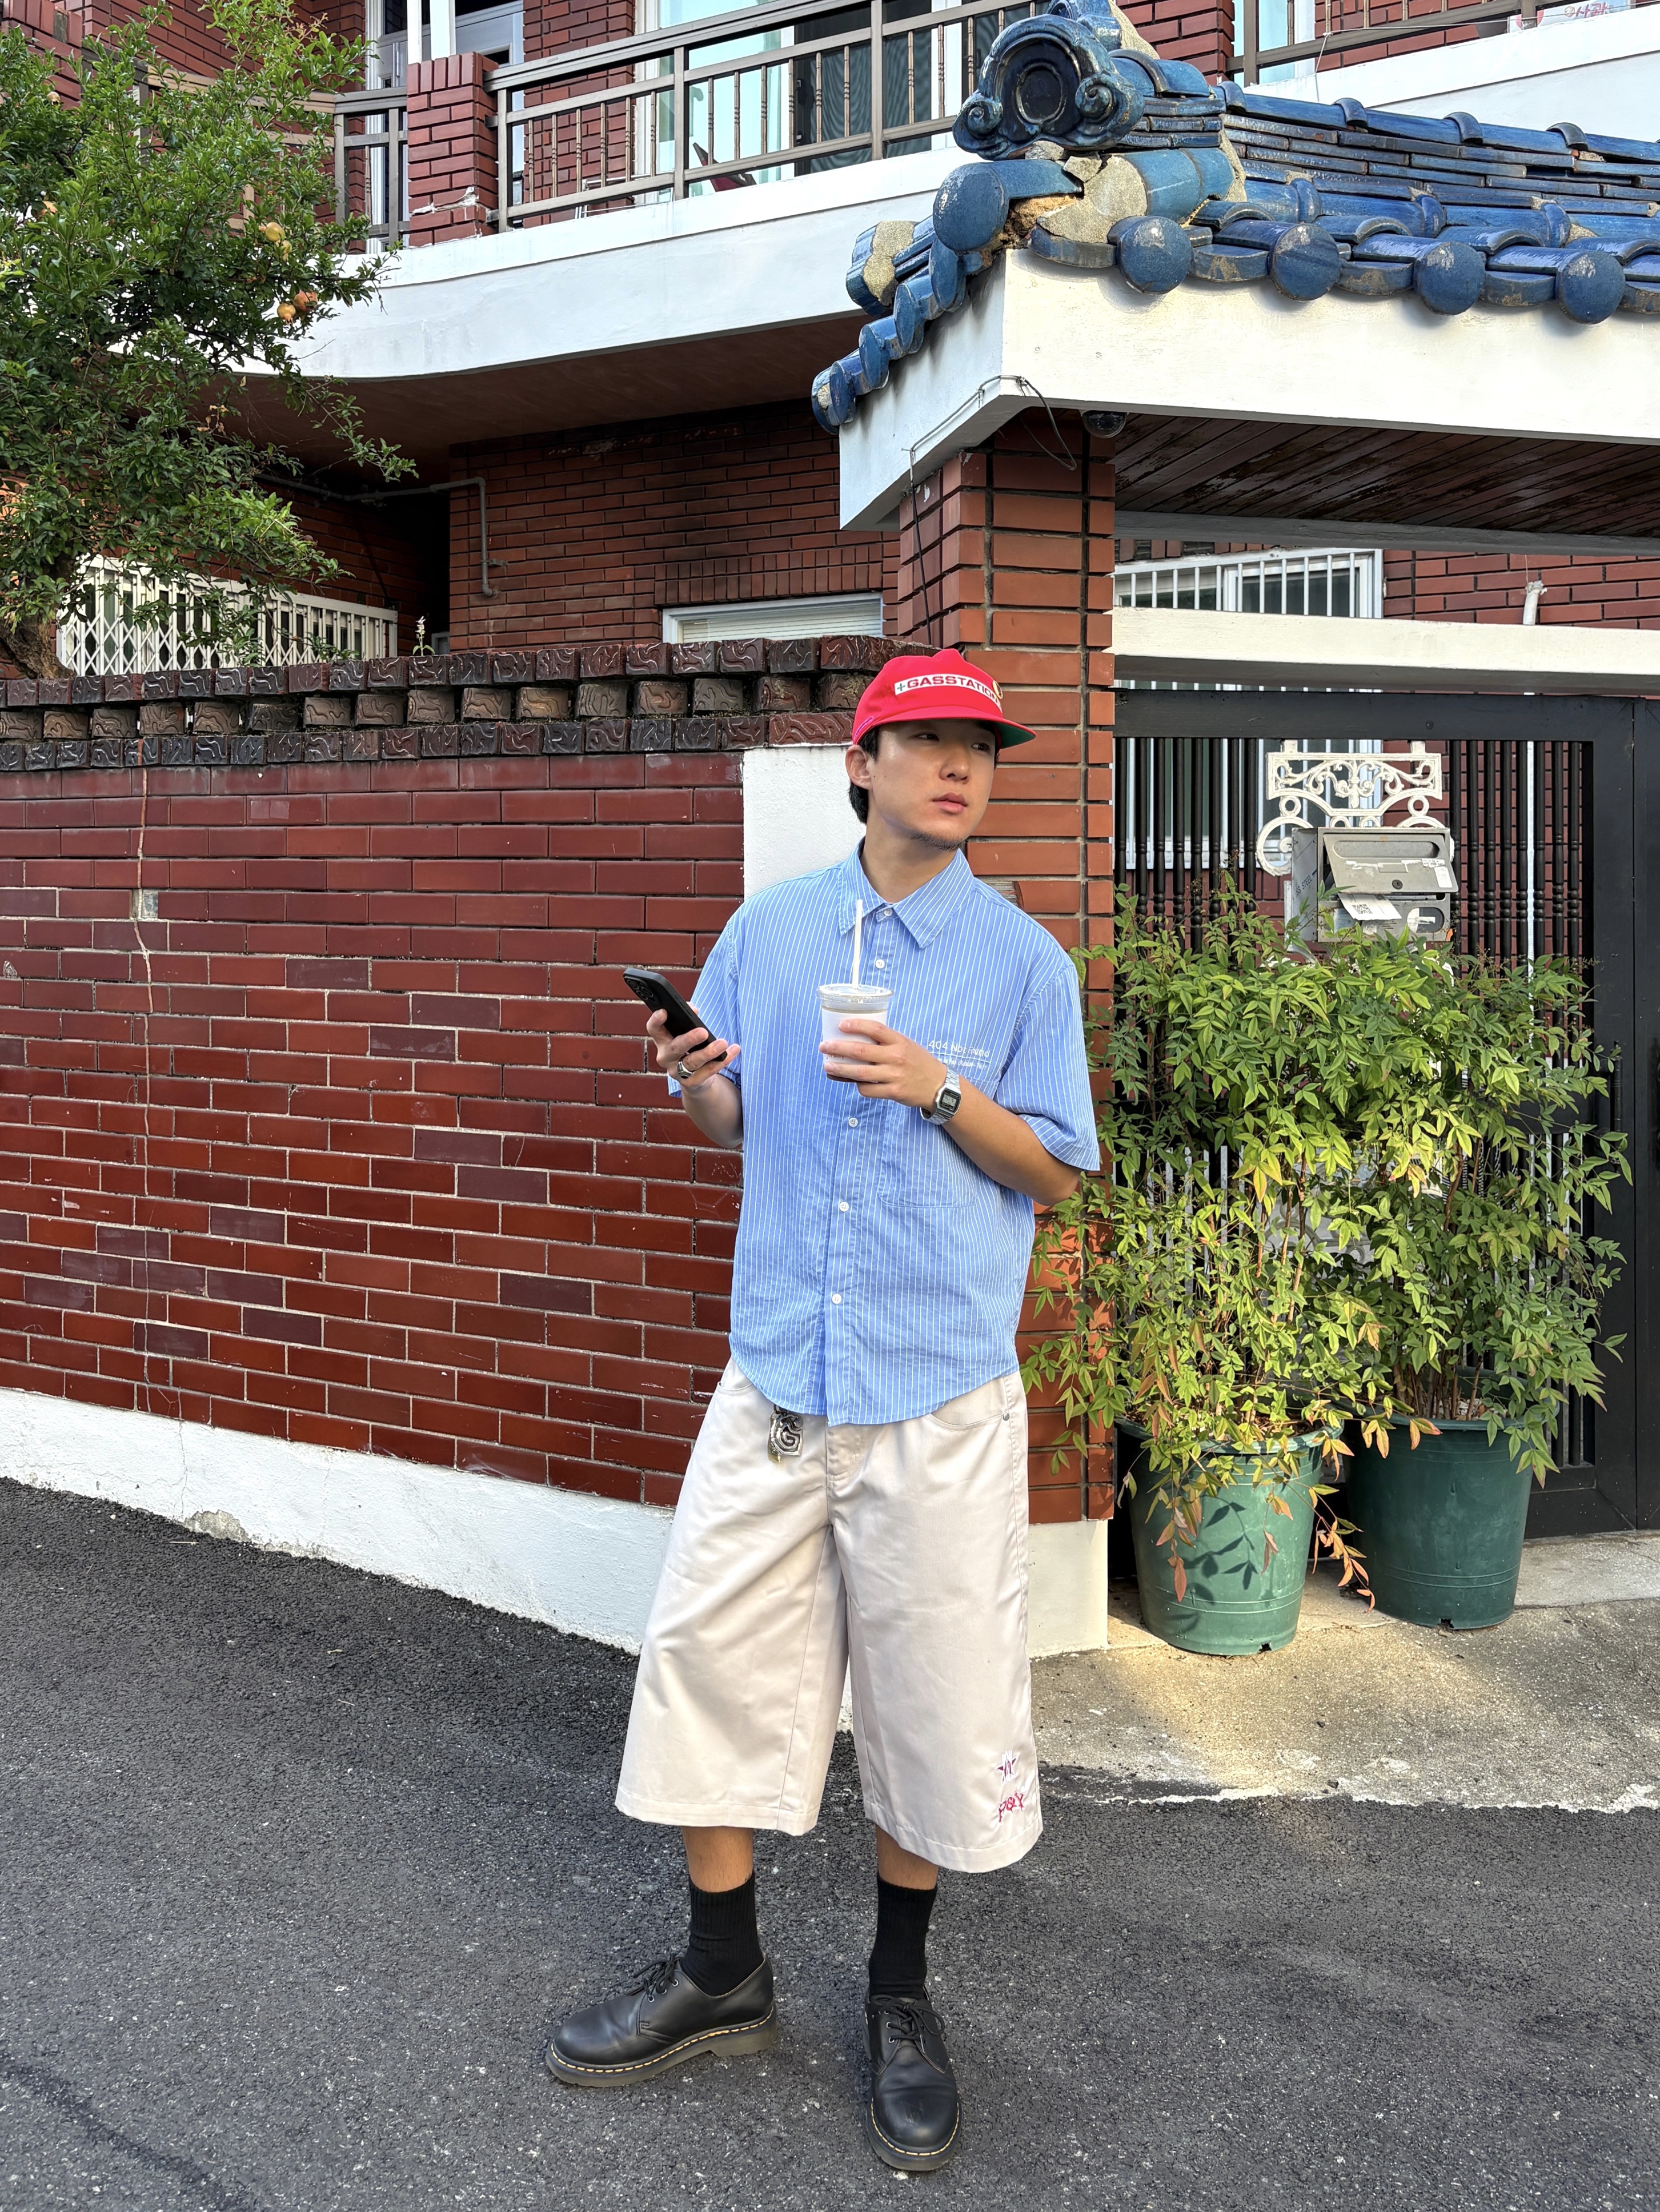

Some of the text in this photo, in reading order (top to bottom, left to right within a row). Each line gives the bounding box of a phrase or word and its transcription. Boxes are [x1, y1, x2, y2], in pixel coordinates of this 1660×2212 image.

[928, 1040, 990, 1058] 404 Not Found
